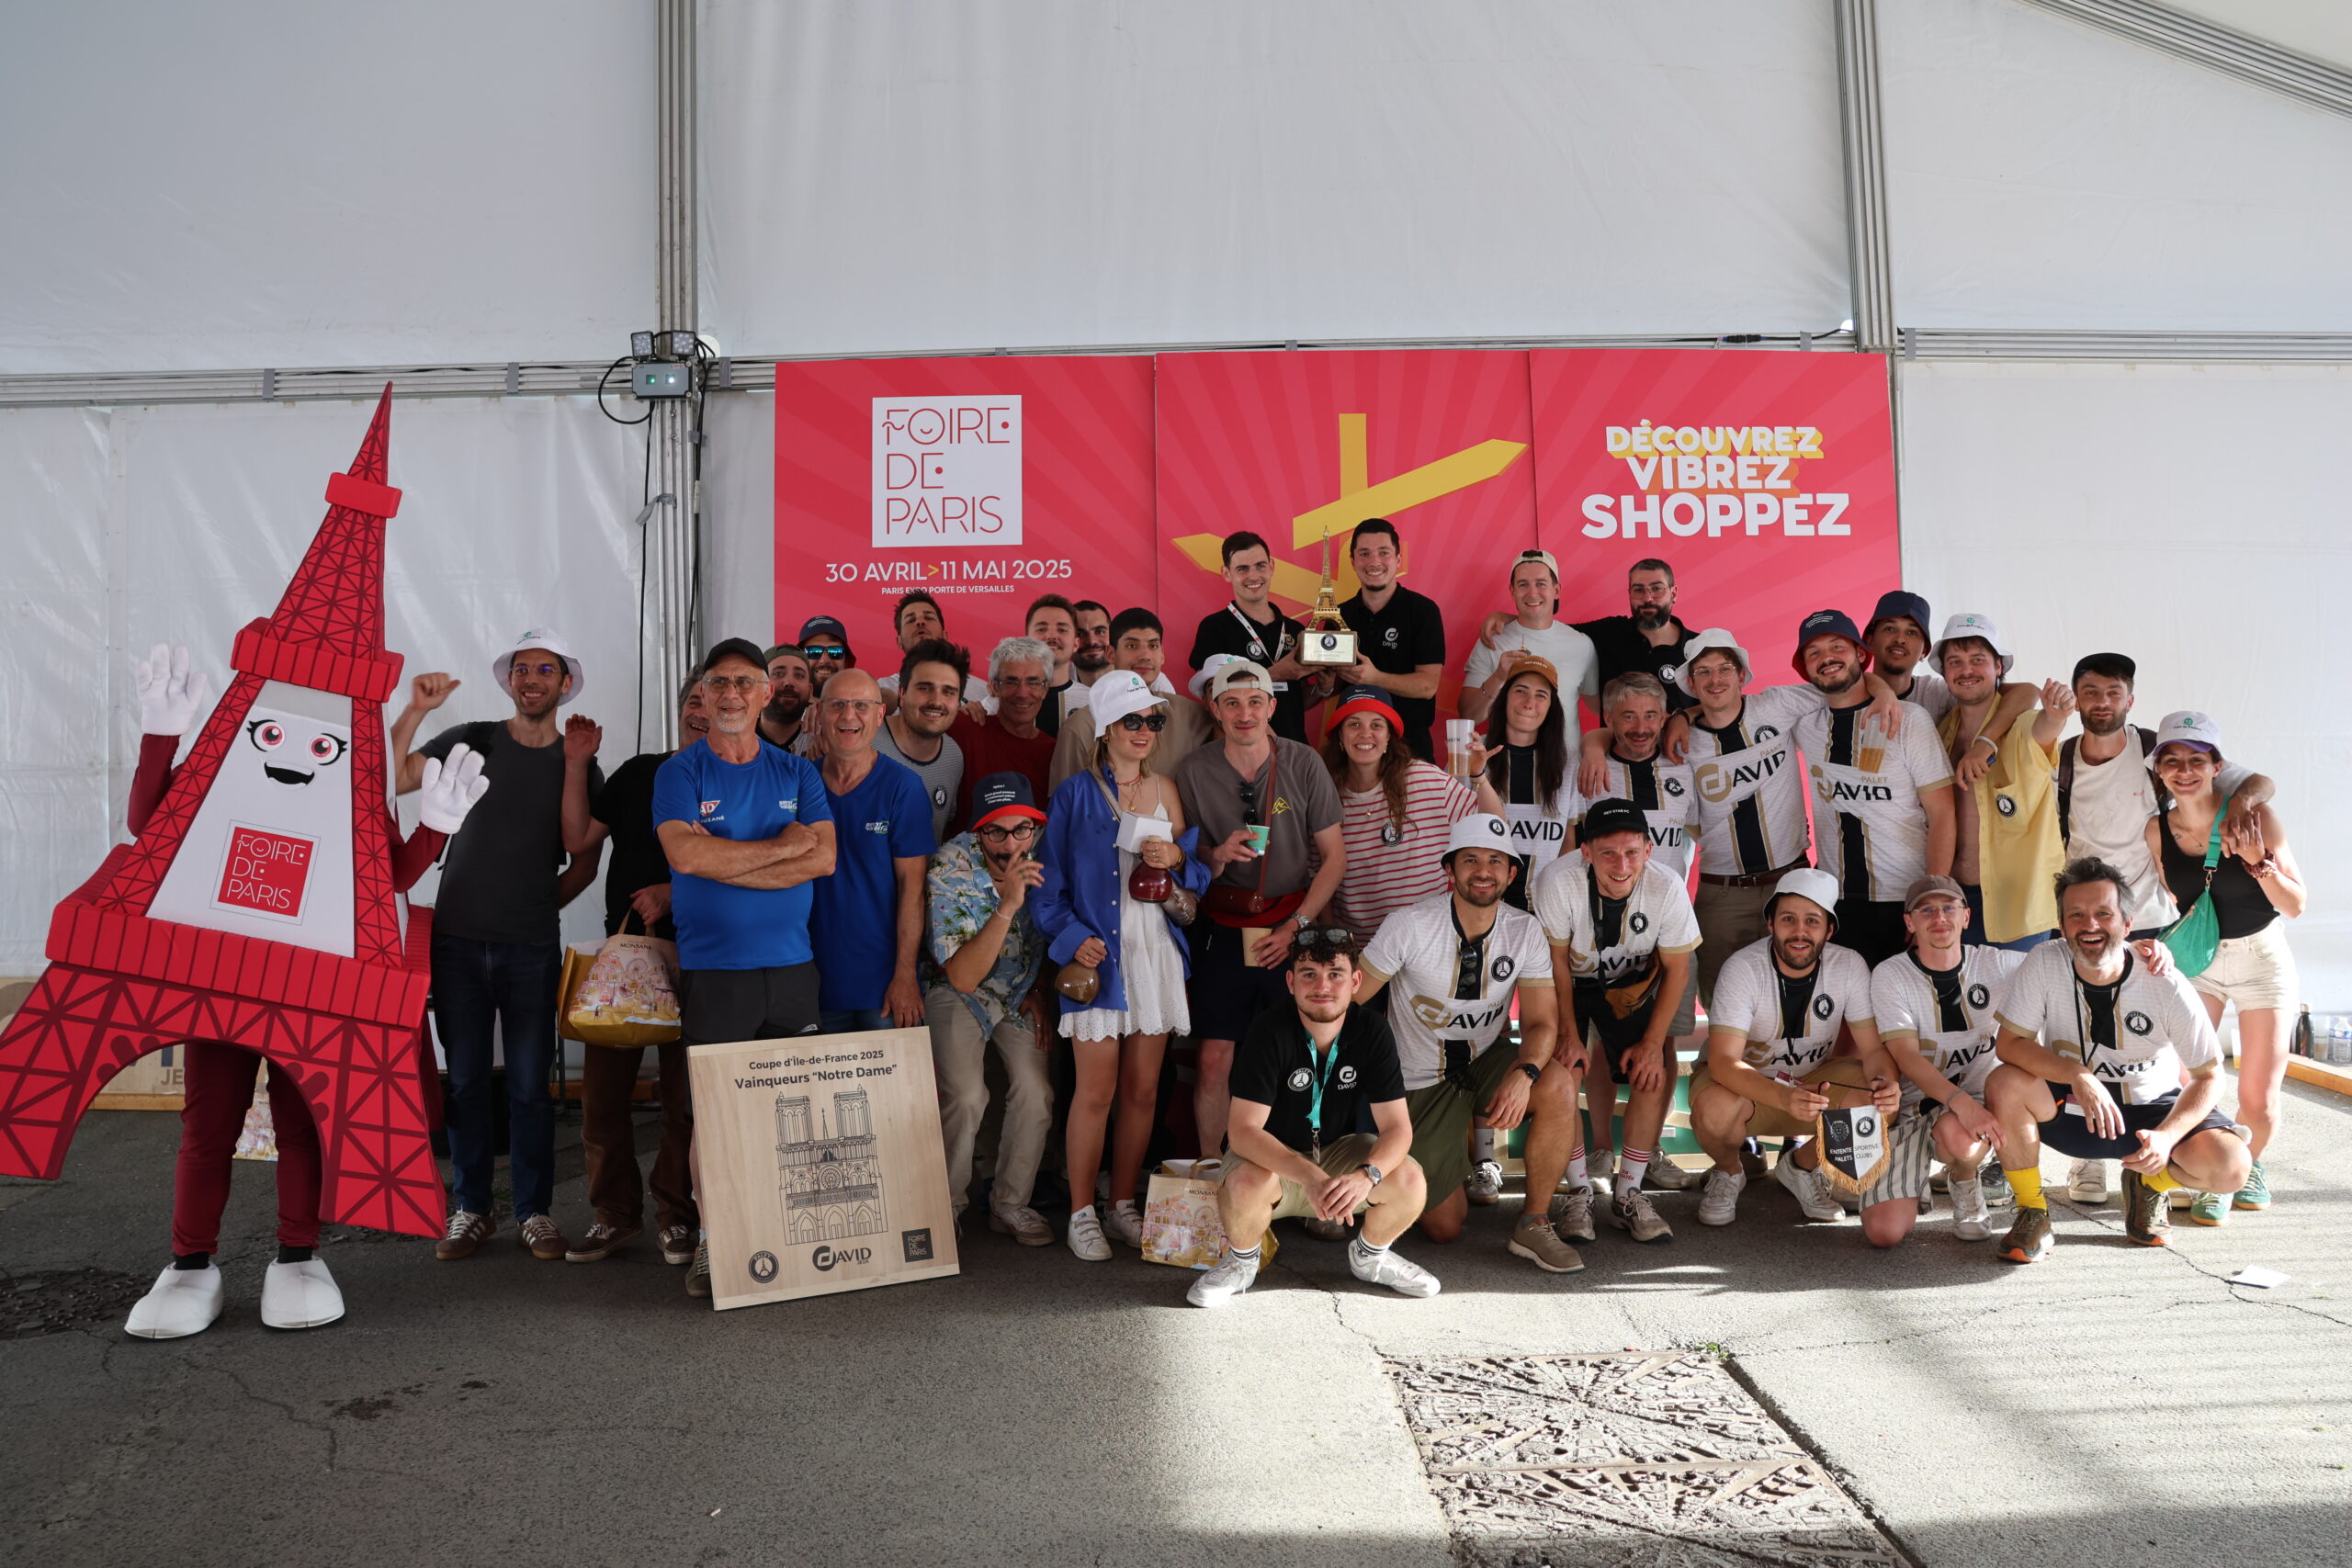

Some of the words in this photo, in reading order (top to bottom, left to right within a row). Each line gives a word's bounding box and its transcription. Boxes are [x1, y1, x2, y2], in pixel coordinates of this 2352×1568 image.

[882, 407, 1011, 446] FOIRE
[1606, 419, 1818, 453] DÉCOUVREZ
[886, 452, 944, 490] DE
[1626, 455, 1792, 490] VIBREZ
[886, 496, 1003, 535] PARIS
[1581, 492, 1851, 539] SHOPPEZ
[826, 563, 858, 582] 30
[963, 560, 1006, 580] MAI
[1012, 559, 1072, 579] 2025
[929, 586, 954, 594] PORTE
[1861, 775, 1889, 784] PALET
[1510, 820, 1564, 841] AVID
[237, 834, 307, 865] FOIRE
[232, 856, 267, 881] DE
[227, 878, 292, 908] PARIS
[749, 1061, 782, 1070] Coupe
[784, 1054, 858, 1067] d'Île-de-France
[860, 1050, 884, 1060] 2025
[161, 1068, 184, 1085] JE
[735, 1073, 809, 1089] Vainqueurs
[812, 1069, 854, 1081] “Notre
[855, 1064, 898, 1077] Dame”
[1338, 1082, 1357, 1090] DAVID
[1830, 1146, 1853, 1155] ENTENTE
